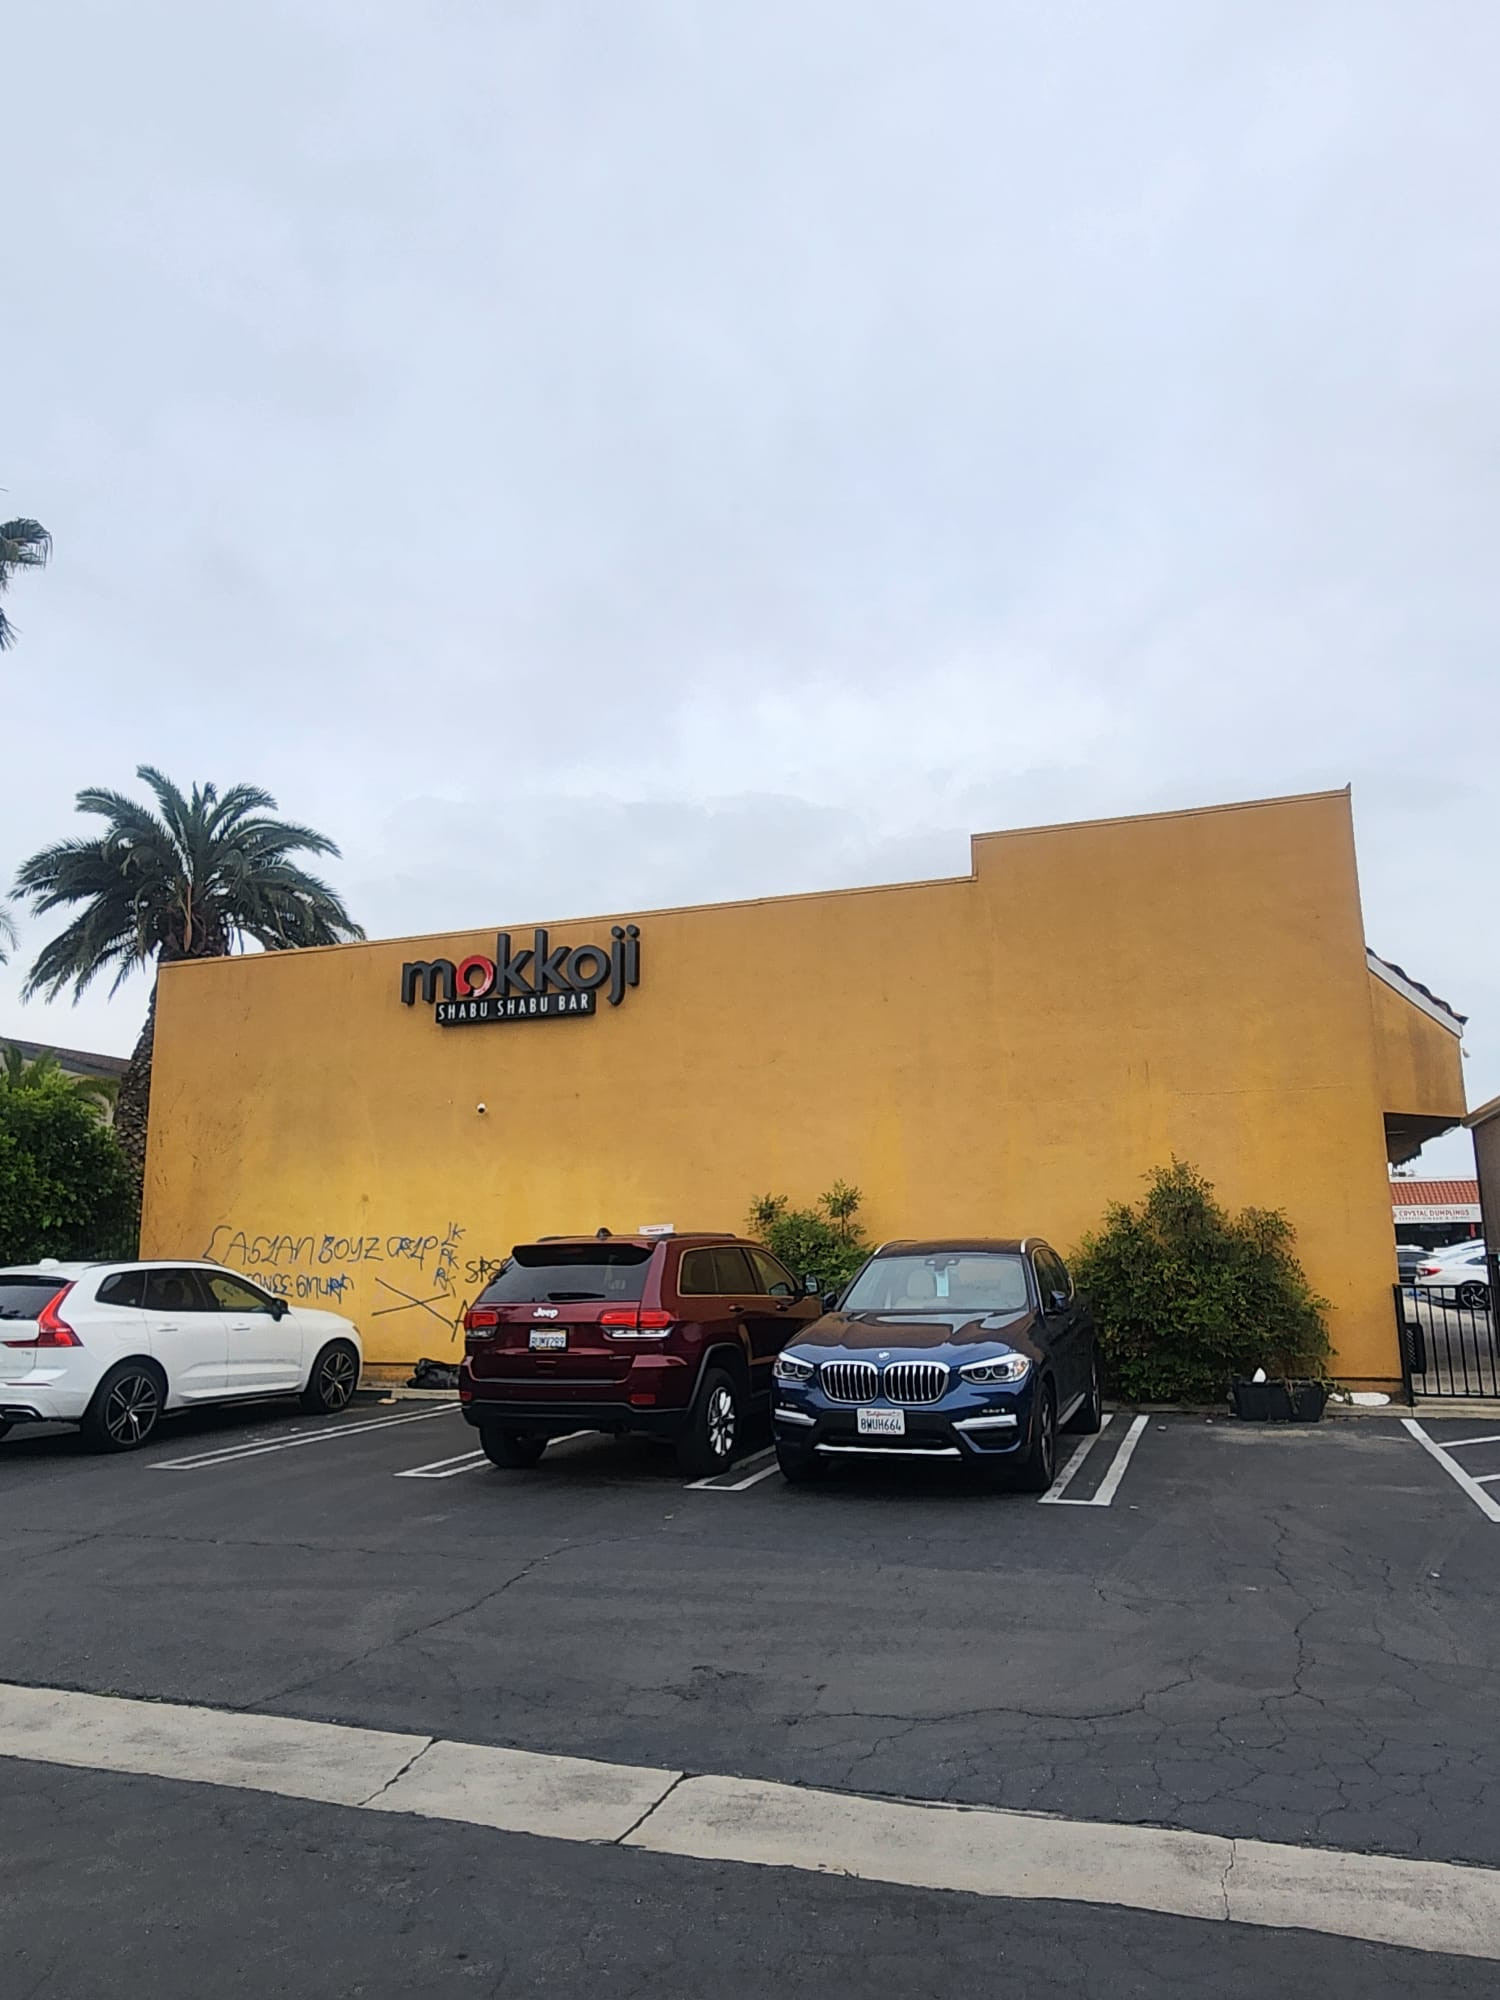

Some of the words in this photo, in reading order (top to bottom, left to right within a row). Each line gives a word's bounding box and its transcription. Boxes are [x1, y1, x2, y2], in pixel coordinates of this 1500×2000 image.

[401, 924, 640, 1007] mokkoji
[438, 1002, 488, 1020] SHABU
[497, 996, 548, 1016] SHABU
[558, 993, 588, 1010] BAR
[1398, 1209, 1428, 1217] CRYSTAL
[1429, 1208, 1470, 1216] DUMPLINGS
[533, 1307, 559, 1319] Jeep
